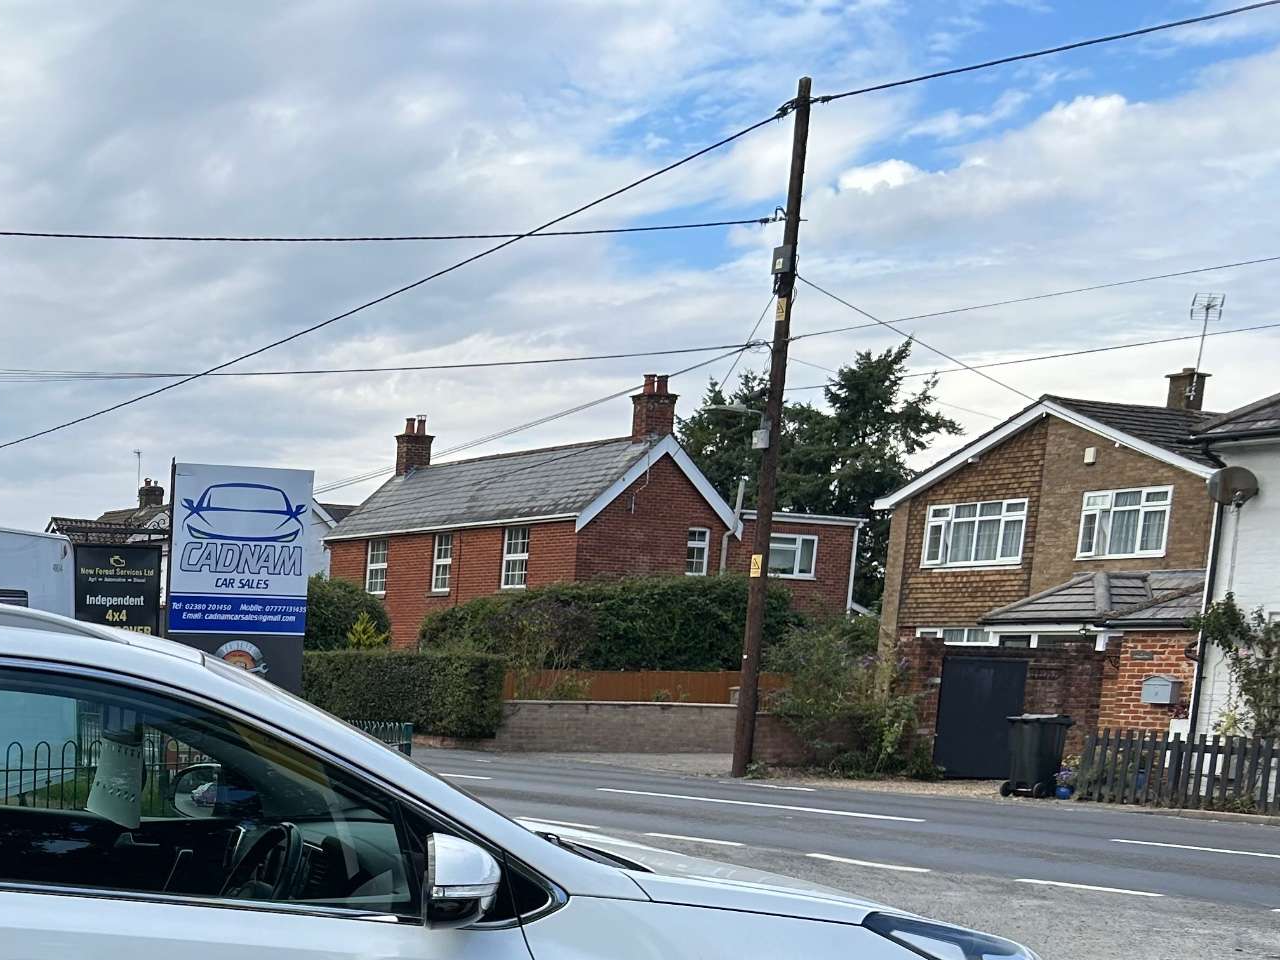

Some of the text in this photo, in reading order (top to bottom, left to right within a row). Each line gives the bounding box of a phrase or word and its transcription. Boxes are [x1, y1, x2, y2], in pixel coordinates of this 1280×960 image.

[180, 541, 303, 577] CADNAM
[80, 567, 155, 577] New Forest Services Ltd
[214, 577, 270, 590] CAR SALES
[86, 594, 145, 608] Independent
[105, 609, 128, 622] 4x4
